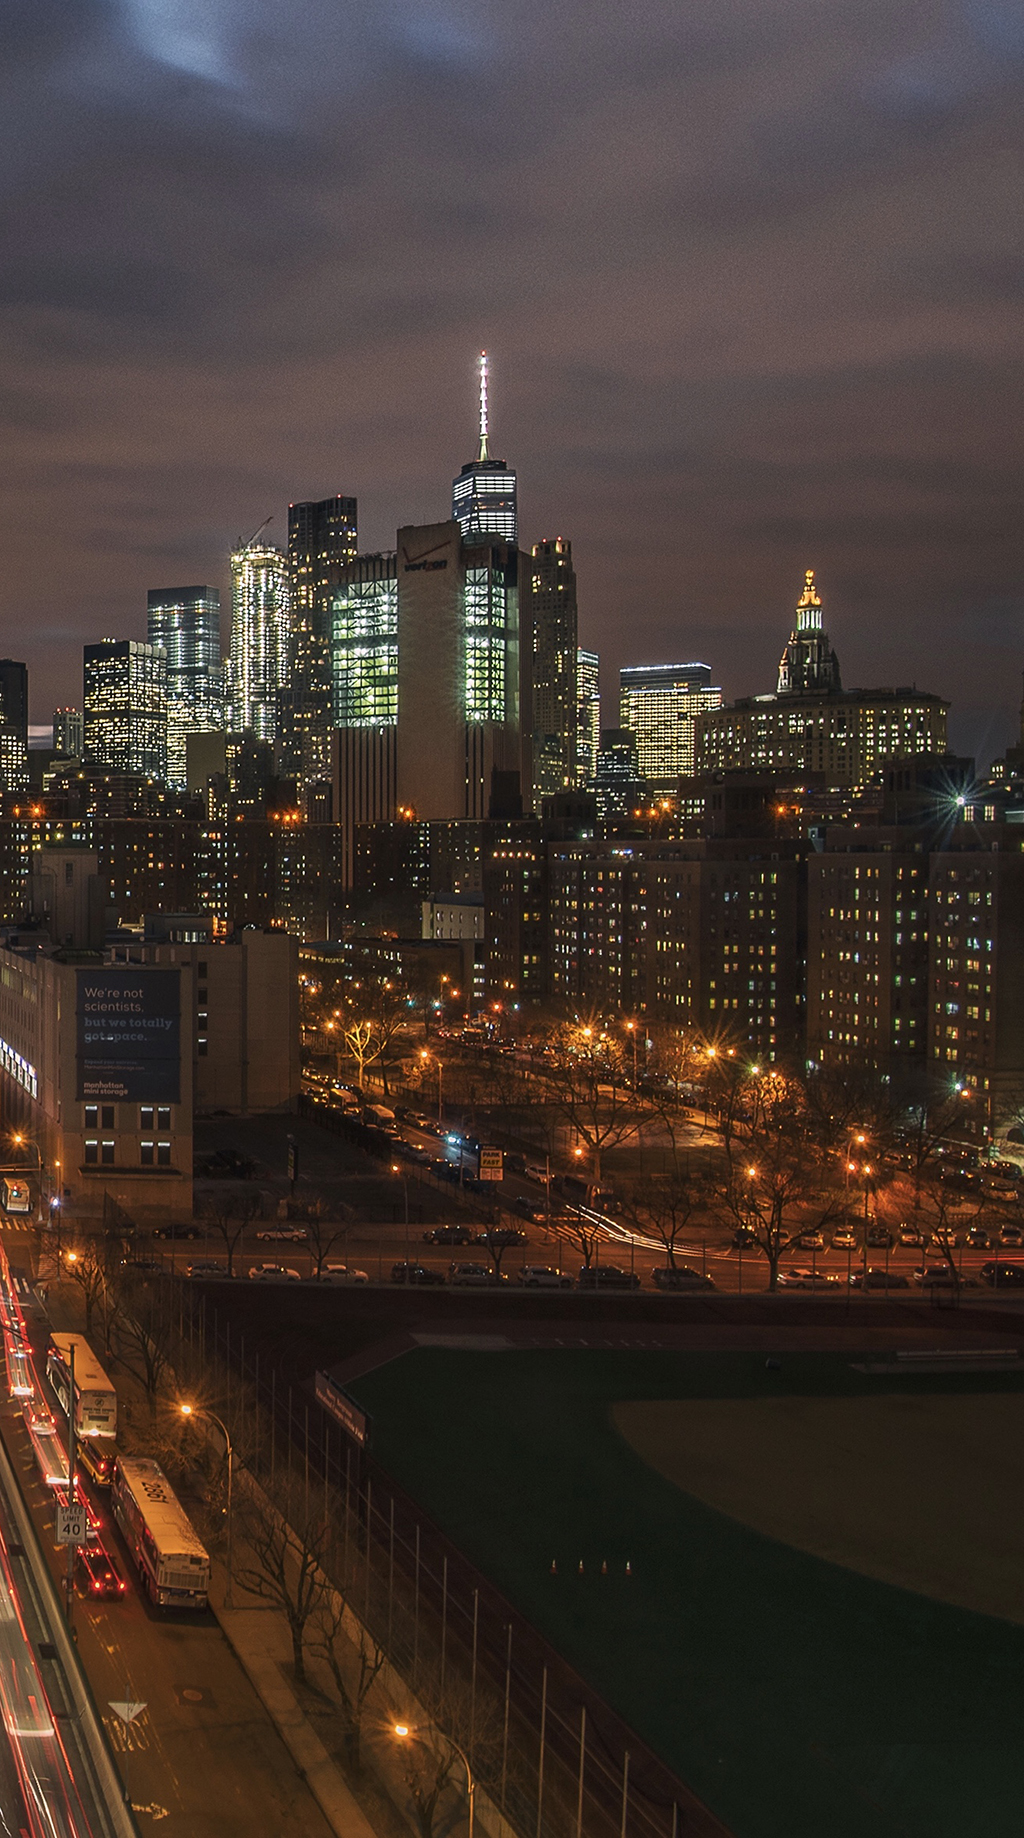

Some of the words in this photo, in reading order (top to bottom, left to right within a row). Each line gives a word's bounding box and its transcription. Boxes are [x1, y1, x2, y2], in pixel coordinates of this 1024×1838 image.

[404, 560, 447, 572] verizon
[84, 987, 120, 998] We're
[123, 988, 144, 998] not
[84, 1001, 144, 1013] scientists,
[84, 1017, 106, 1027] but
[108, 1019, 127, 1027] we
[129, 1018, 173, 1030] totally
[84, 1032, 105, 1043] got
[108, 1033, 148, 1043] space.
[83, 1080, 124, 1089] manhattan
[100, 1089, 128, 1097] storage
[60, 1507, 83, 1515] SPEED
[63, 1523, 81, 1536] 40
